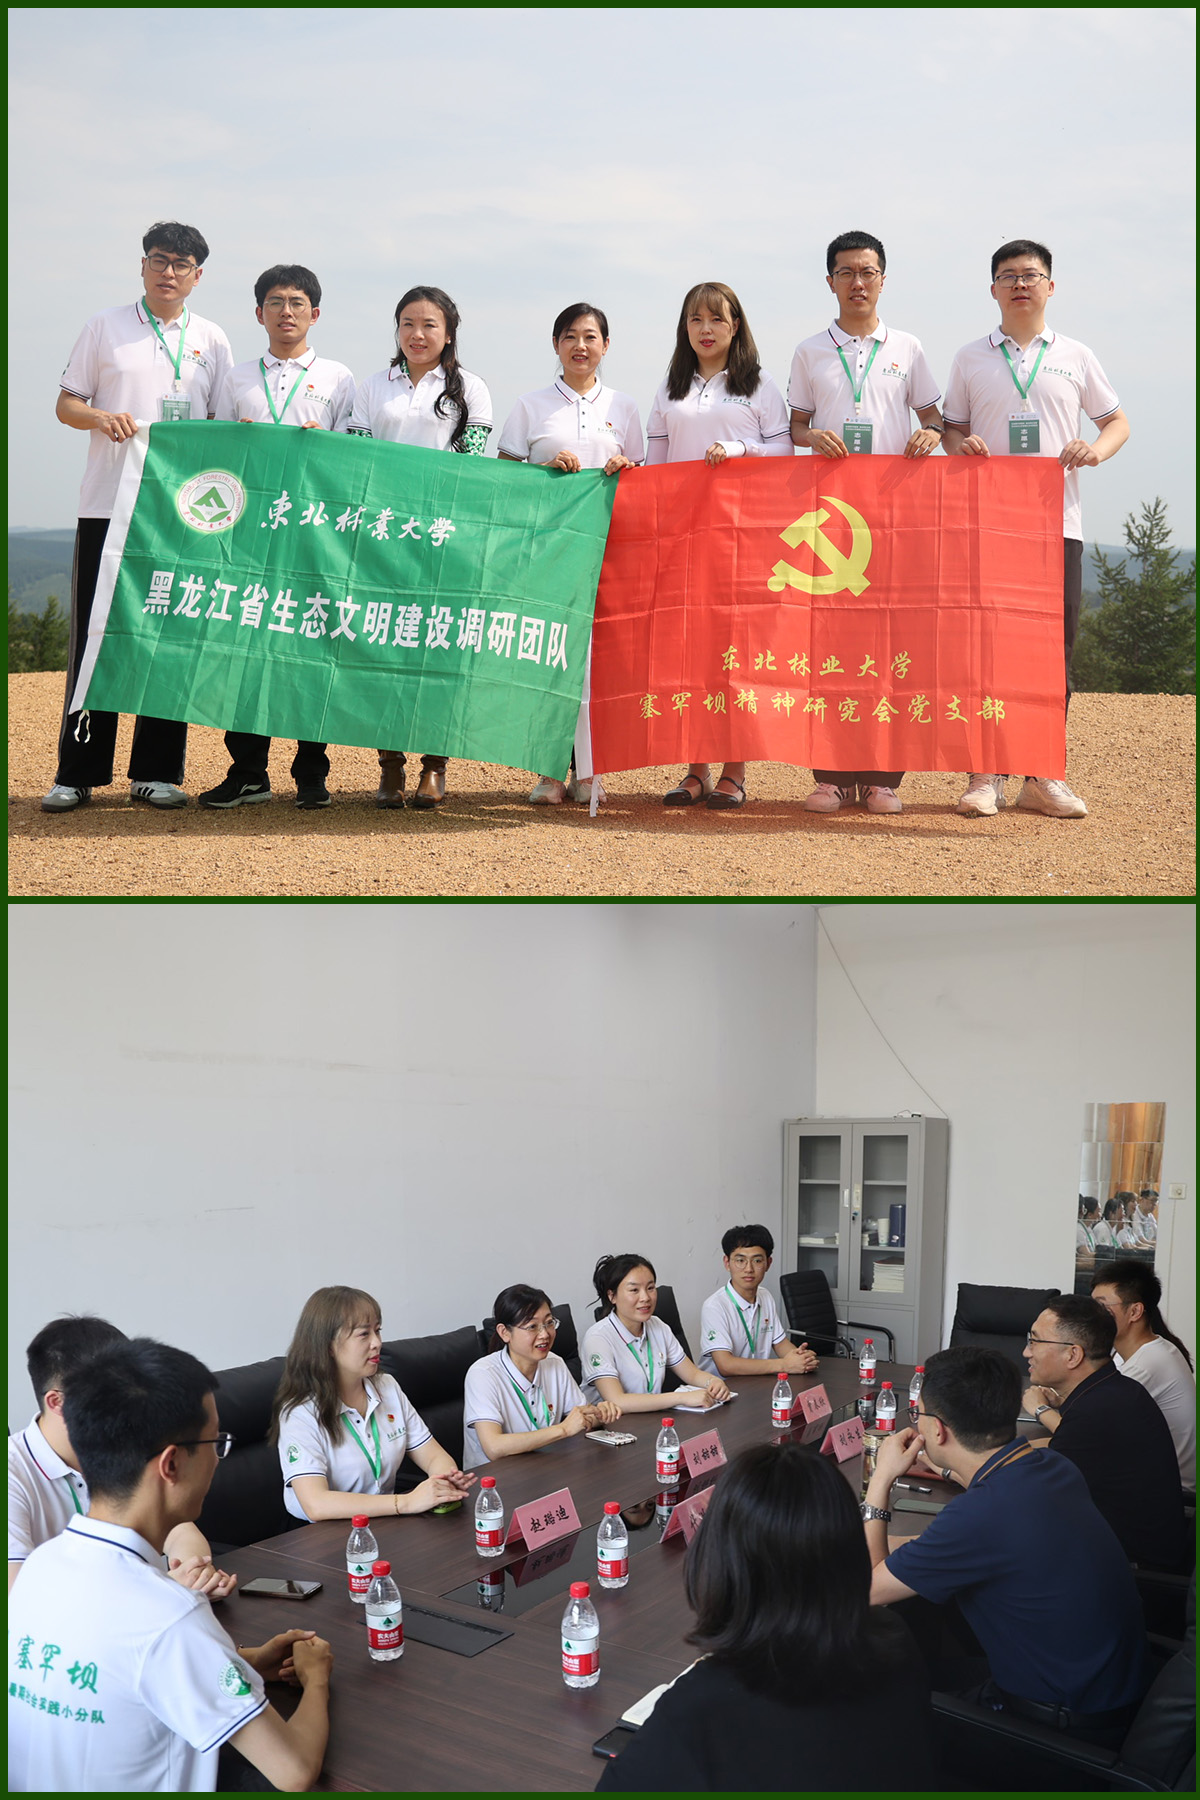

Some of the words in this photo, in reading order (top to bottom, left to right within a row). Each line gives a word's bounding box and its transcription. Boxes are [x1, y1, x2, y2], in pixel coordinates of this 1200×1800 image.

[142, 569, 570, 672] 黑龙江省生态文明建设调研团队
[720, 644, 913, 680] 东北林业大学
[638, 689, 1007, 727] 塞罕坝精神研究会党支部
[13, 1634, 98, 1695] 塞罕坝
